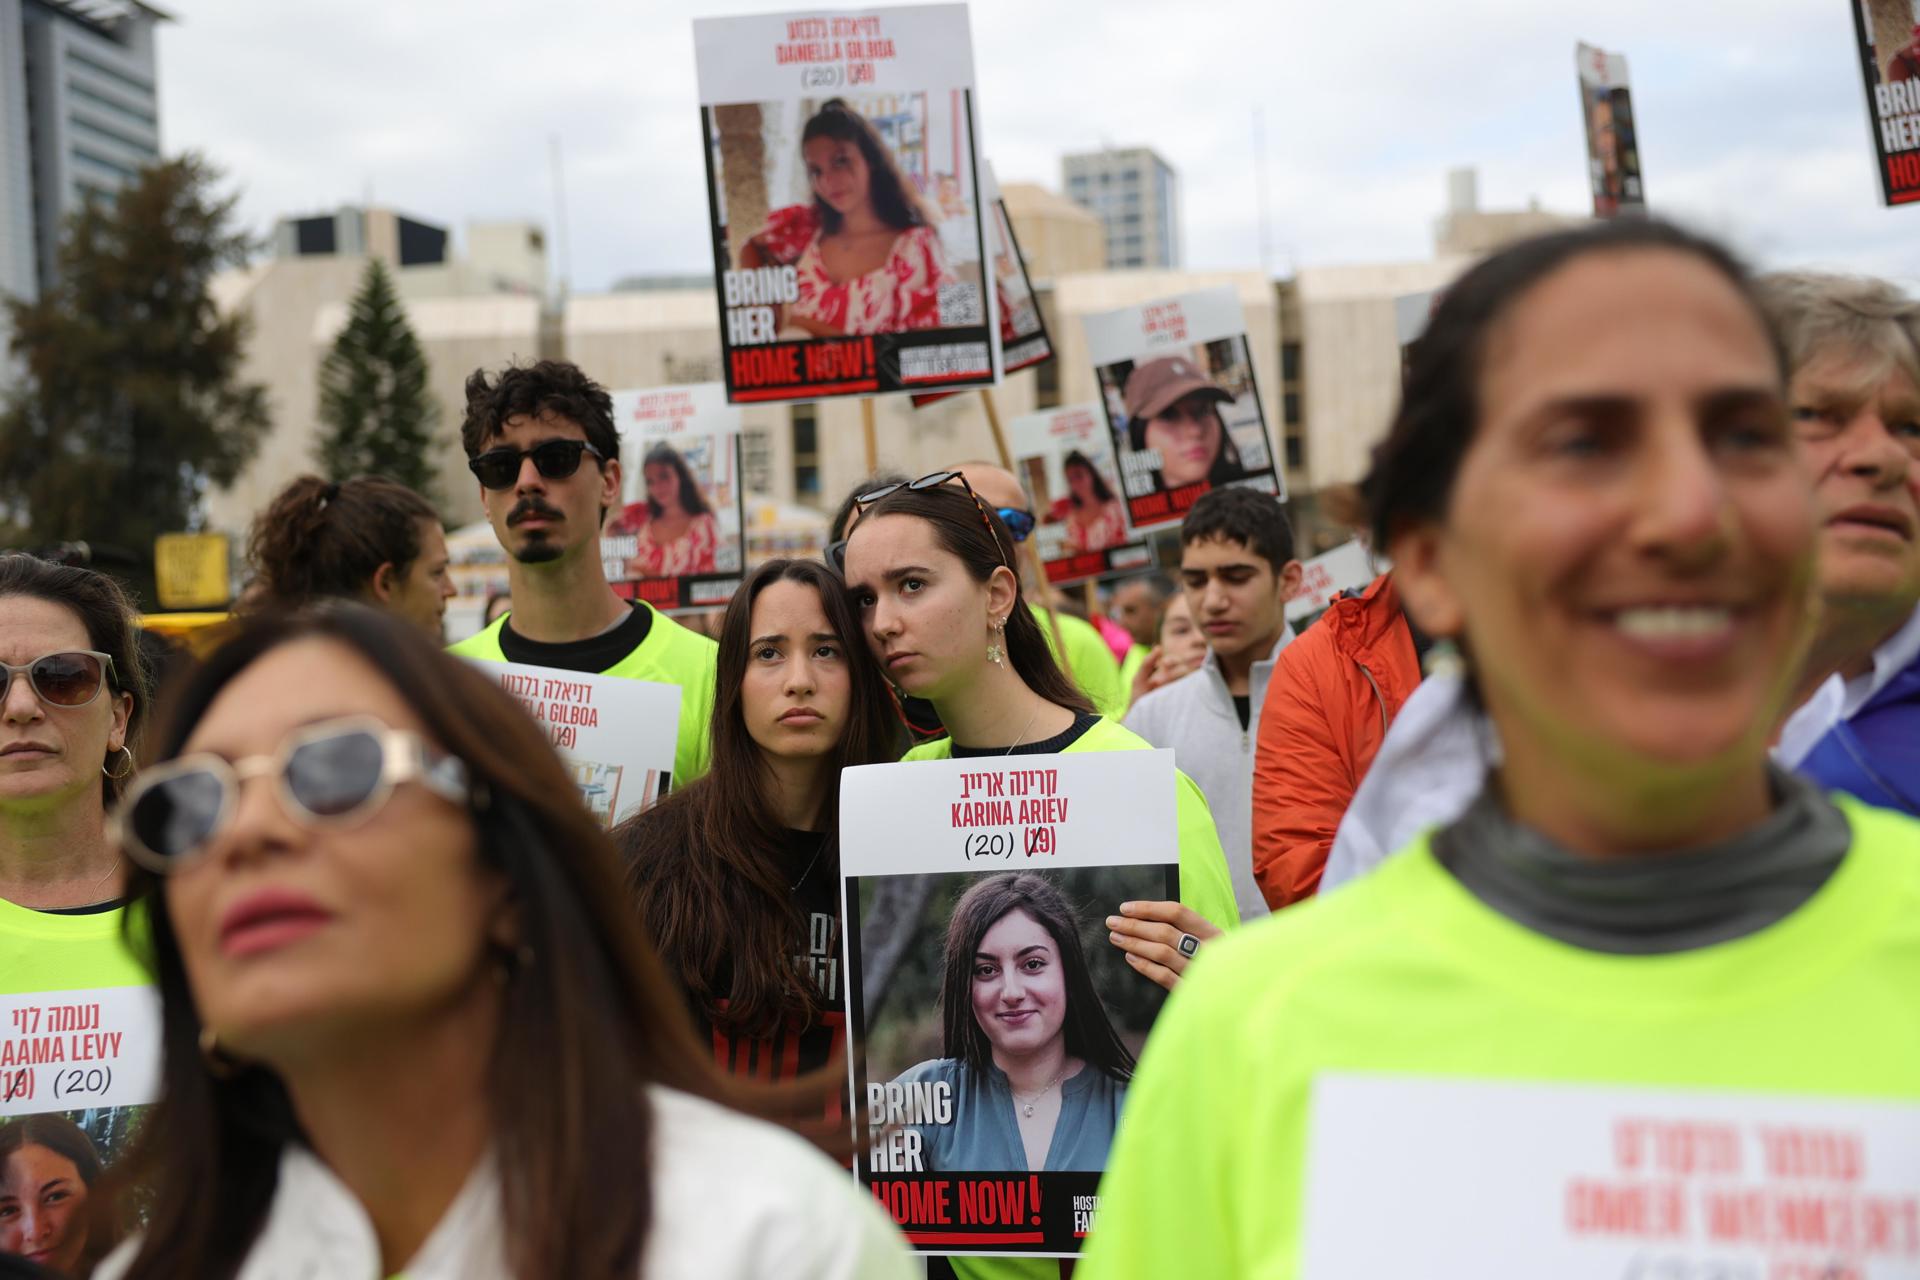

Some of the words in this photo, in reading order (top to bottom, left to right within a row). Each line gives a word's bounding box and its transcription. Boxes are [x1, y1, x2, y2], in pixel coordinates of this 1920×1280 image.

[723, 264, 799, 306] BRING
[727, 307, 777, 346] HER
[731, 345, 801, 387] HOME
[805, 335, 876, 381] NOW!
[544, 680, 592, 704] דניאלה
[549, 703, 598, 728] GILBOA
[960, 772, 1005, 798] ארייב
[1009, 769, 1058, 797] קרינה
[951, 800, 1014, 828] KARINA
[1018, 798, 1068, 824] ARIEV
[965, 831, 1014, 861] (20)
[1024, 826, 1056, 857] (19)
[12, 1006, 42, 1034] לוי
[48, 1004, 100, 1033] נעמה
[0, 1036, 65, 1067] AAMA
[71, 1032, 123, 1061] LEVY
[0, 1067, 35, 1102] 19)
[54, 1066, 111, 1100] (20)
[867, 1081, 952, 1125] BRING
[870, 1129, 924, 1172] HER
[871, 1180, 951, 1225] HOME
[958, 1174, 1043, 1226] NOW!
